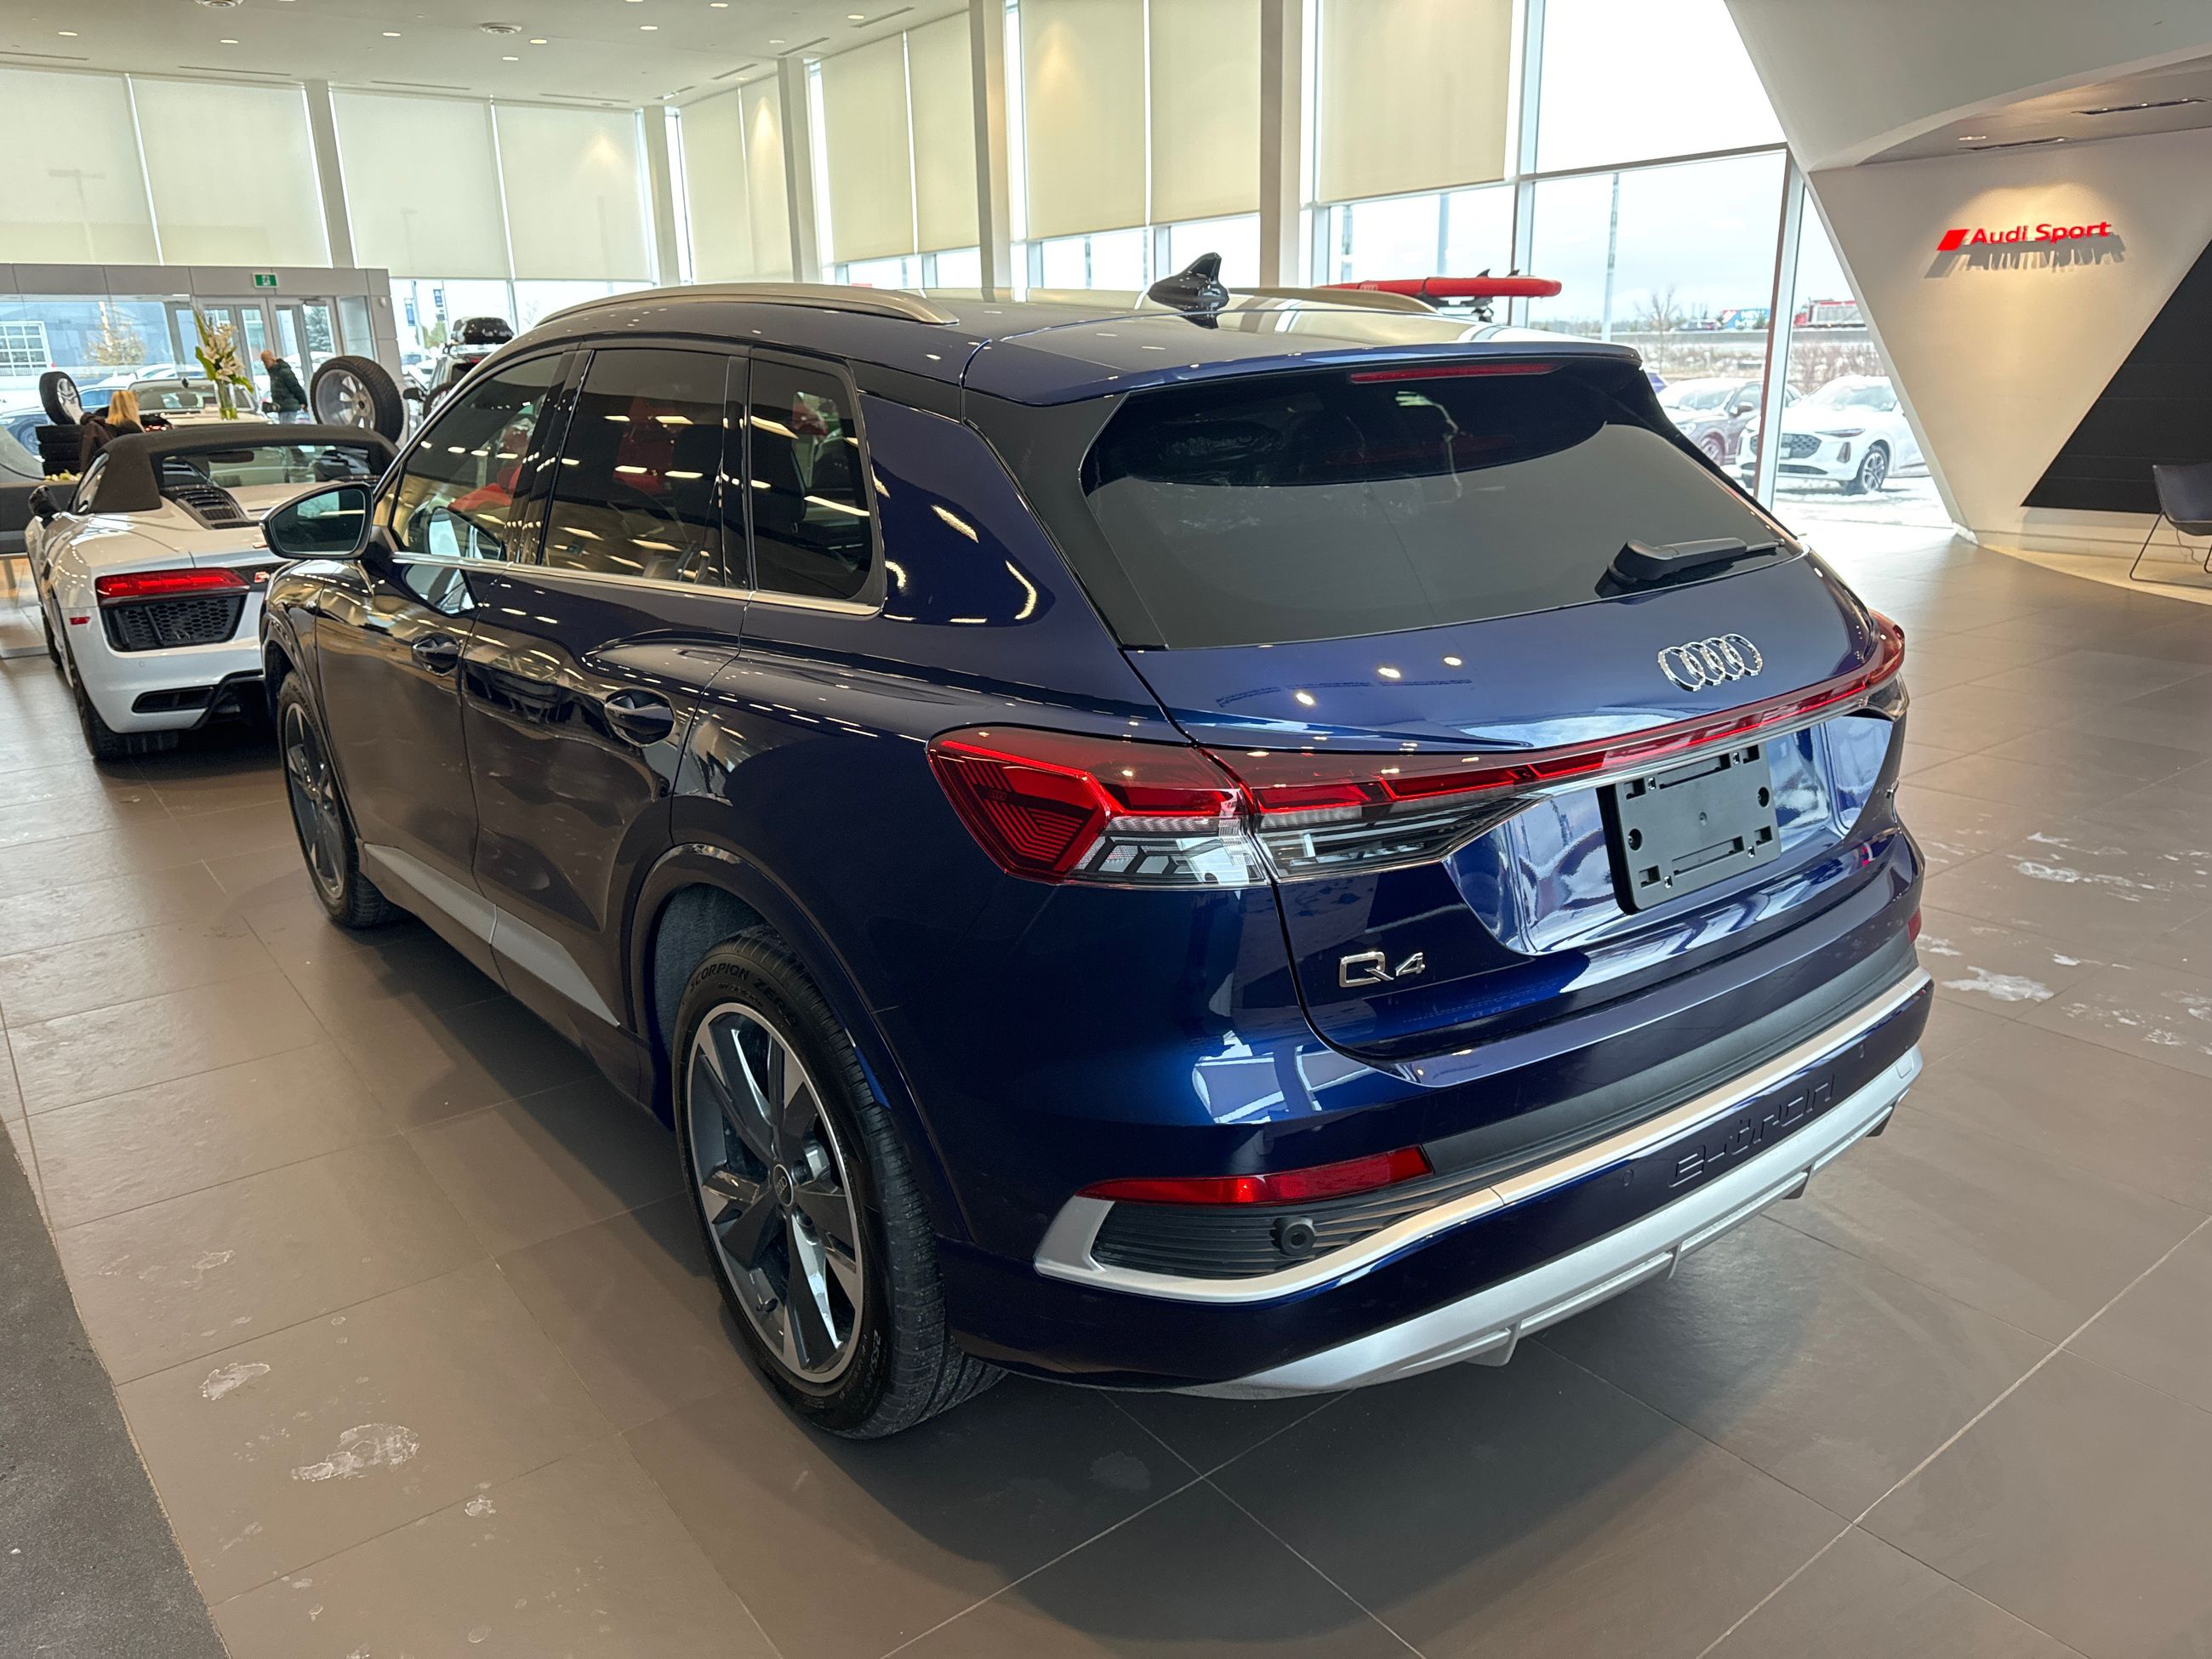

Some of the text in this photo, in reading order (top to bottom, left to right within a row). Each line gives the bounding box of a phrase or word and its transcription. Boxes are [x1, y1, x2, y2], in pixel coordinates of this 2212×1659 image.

[1970, 221, 2112, 245] Audi Sport
[690, 962, 750, 994] SCORPION
[1339, 951, 1426, 988] Q4
